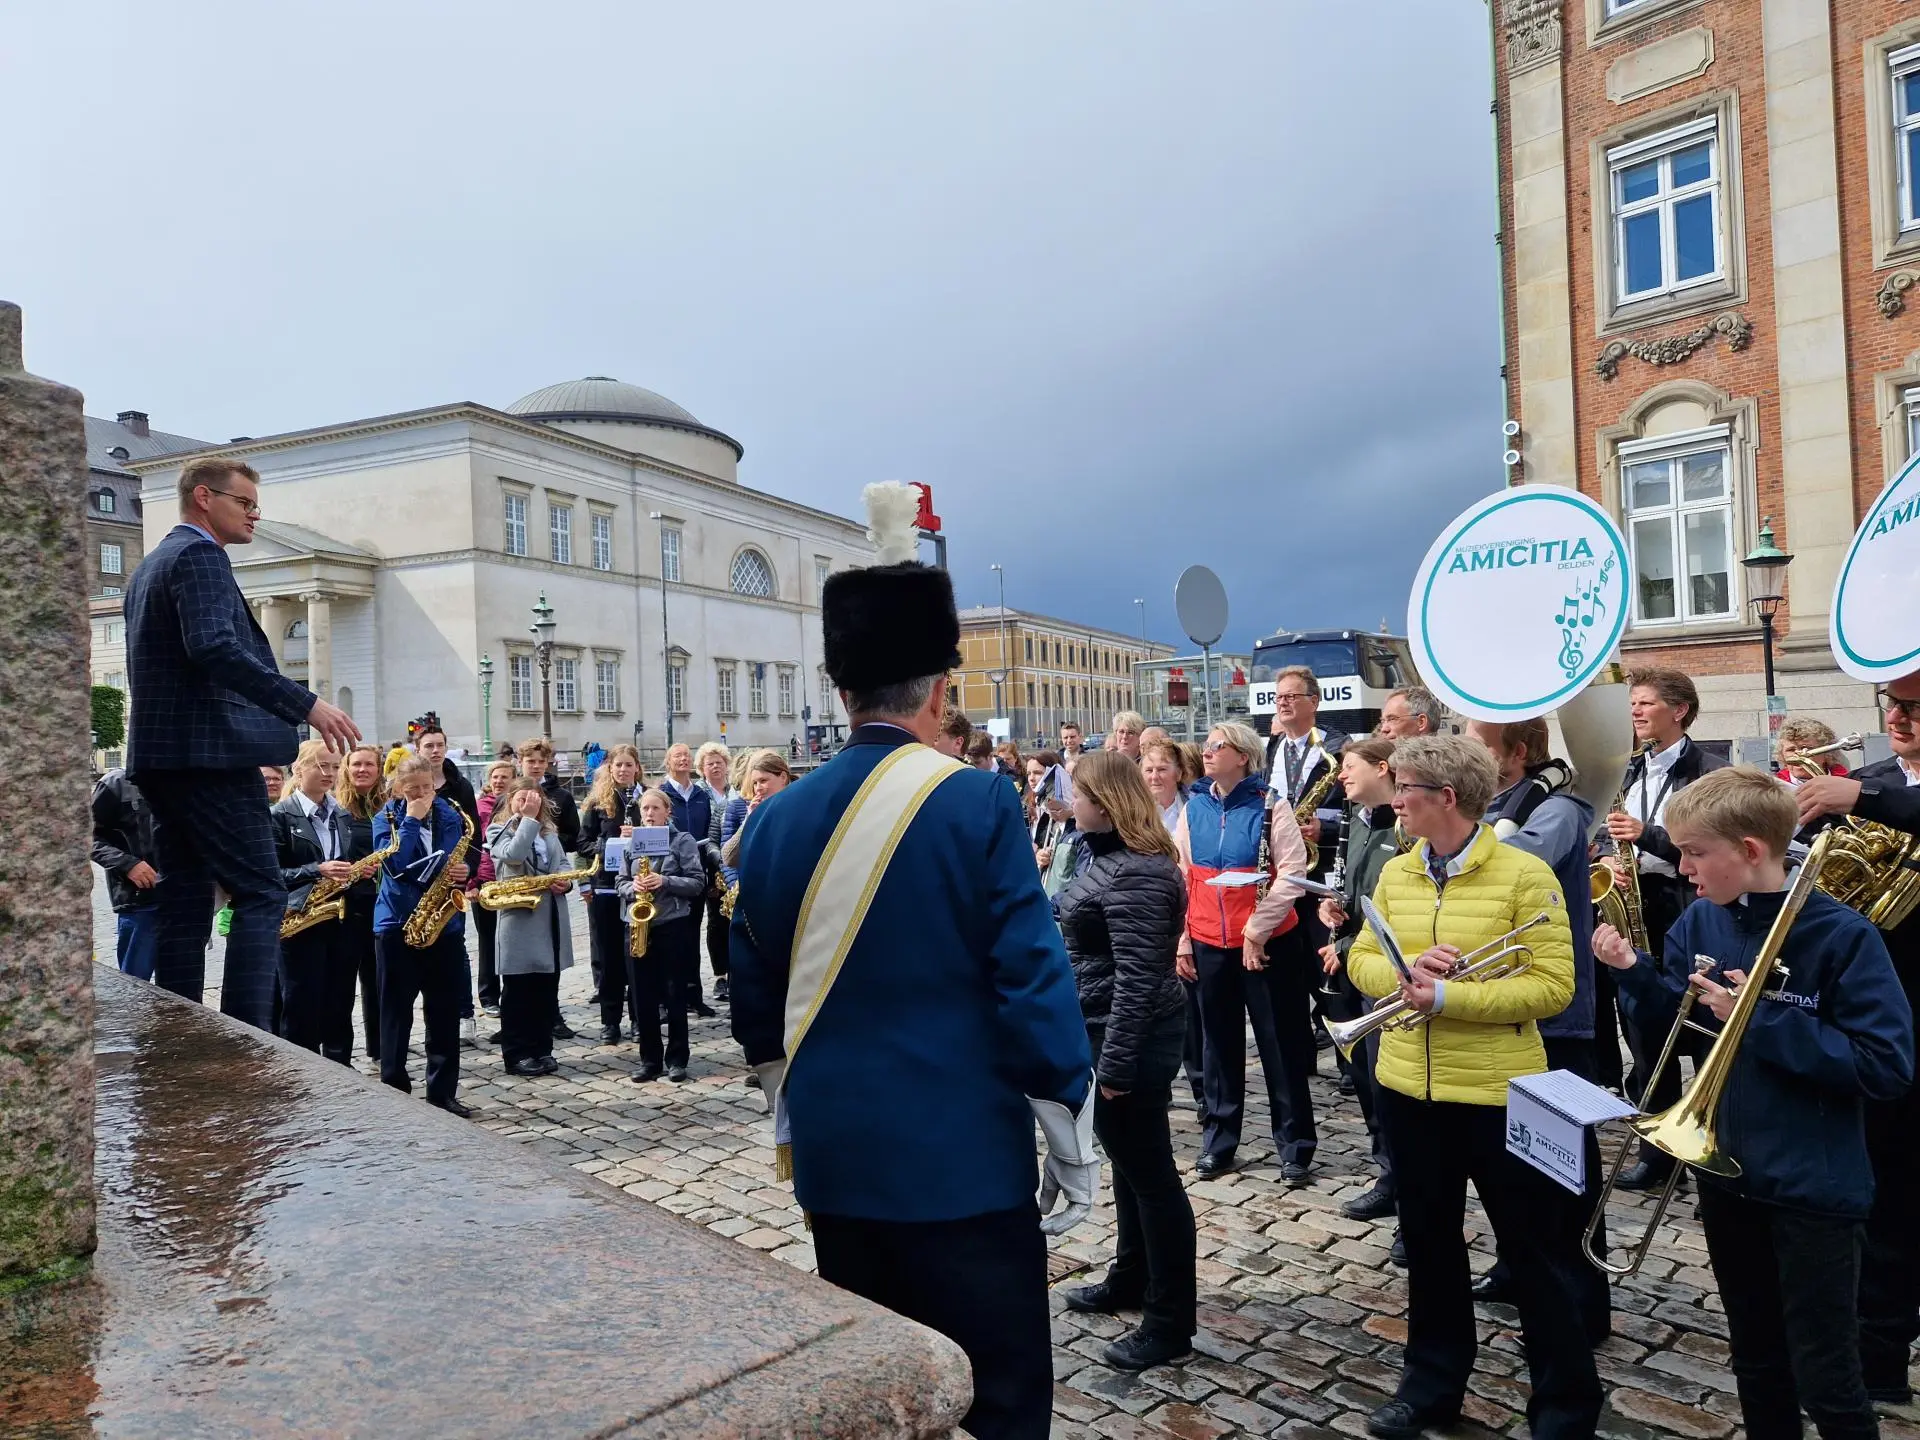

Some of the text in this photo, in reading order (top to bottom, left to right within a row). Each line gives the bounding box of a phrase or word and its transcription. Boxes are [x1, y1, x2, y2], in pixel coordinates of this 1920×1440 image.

[1448, 537, 1594, 574] AMICITIA
[1455, 537, 1536, 553] MUZIEKVERENIGING
[1557, 559, 1595, 570] DELDEN
[1535, 1137, 1577, 1167] AMICITIA
